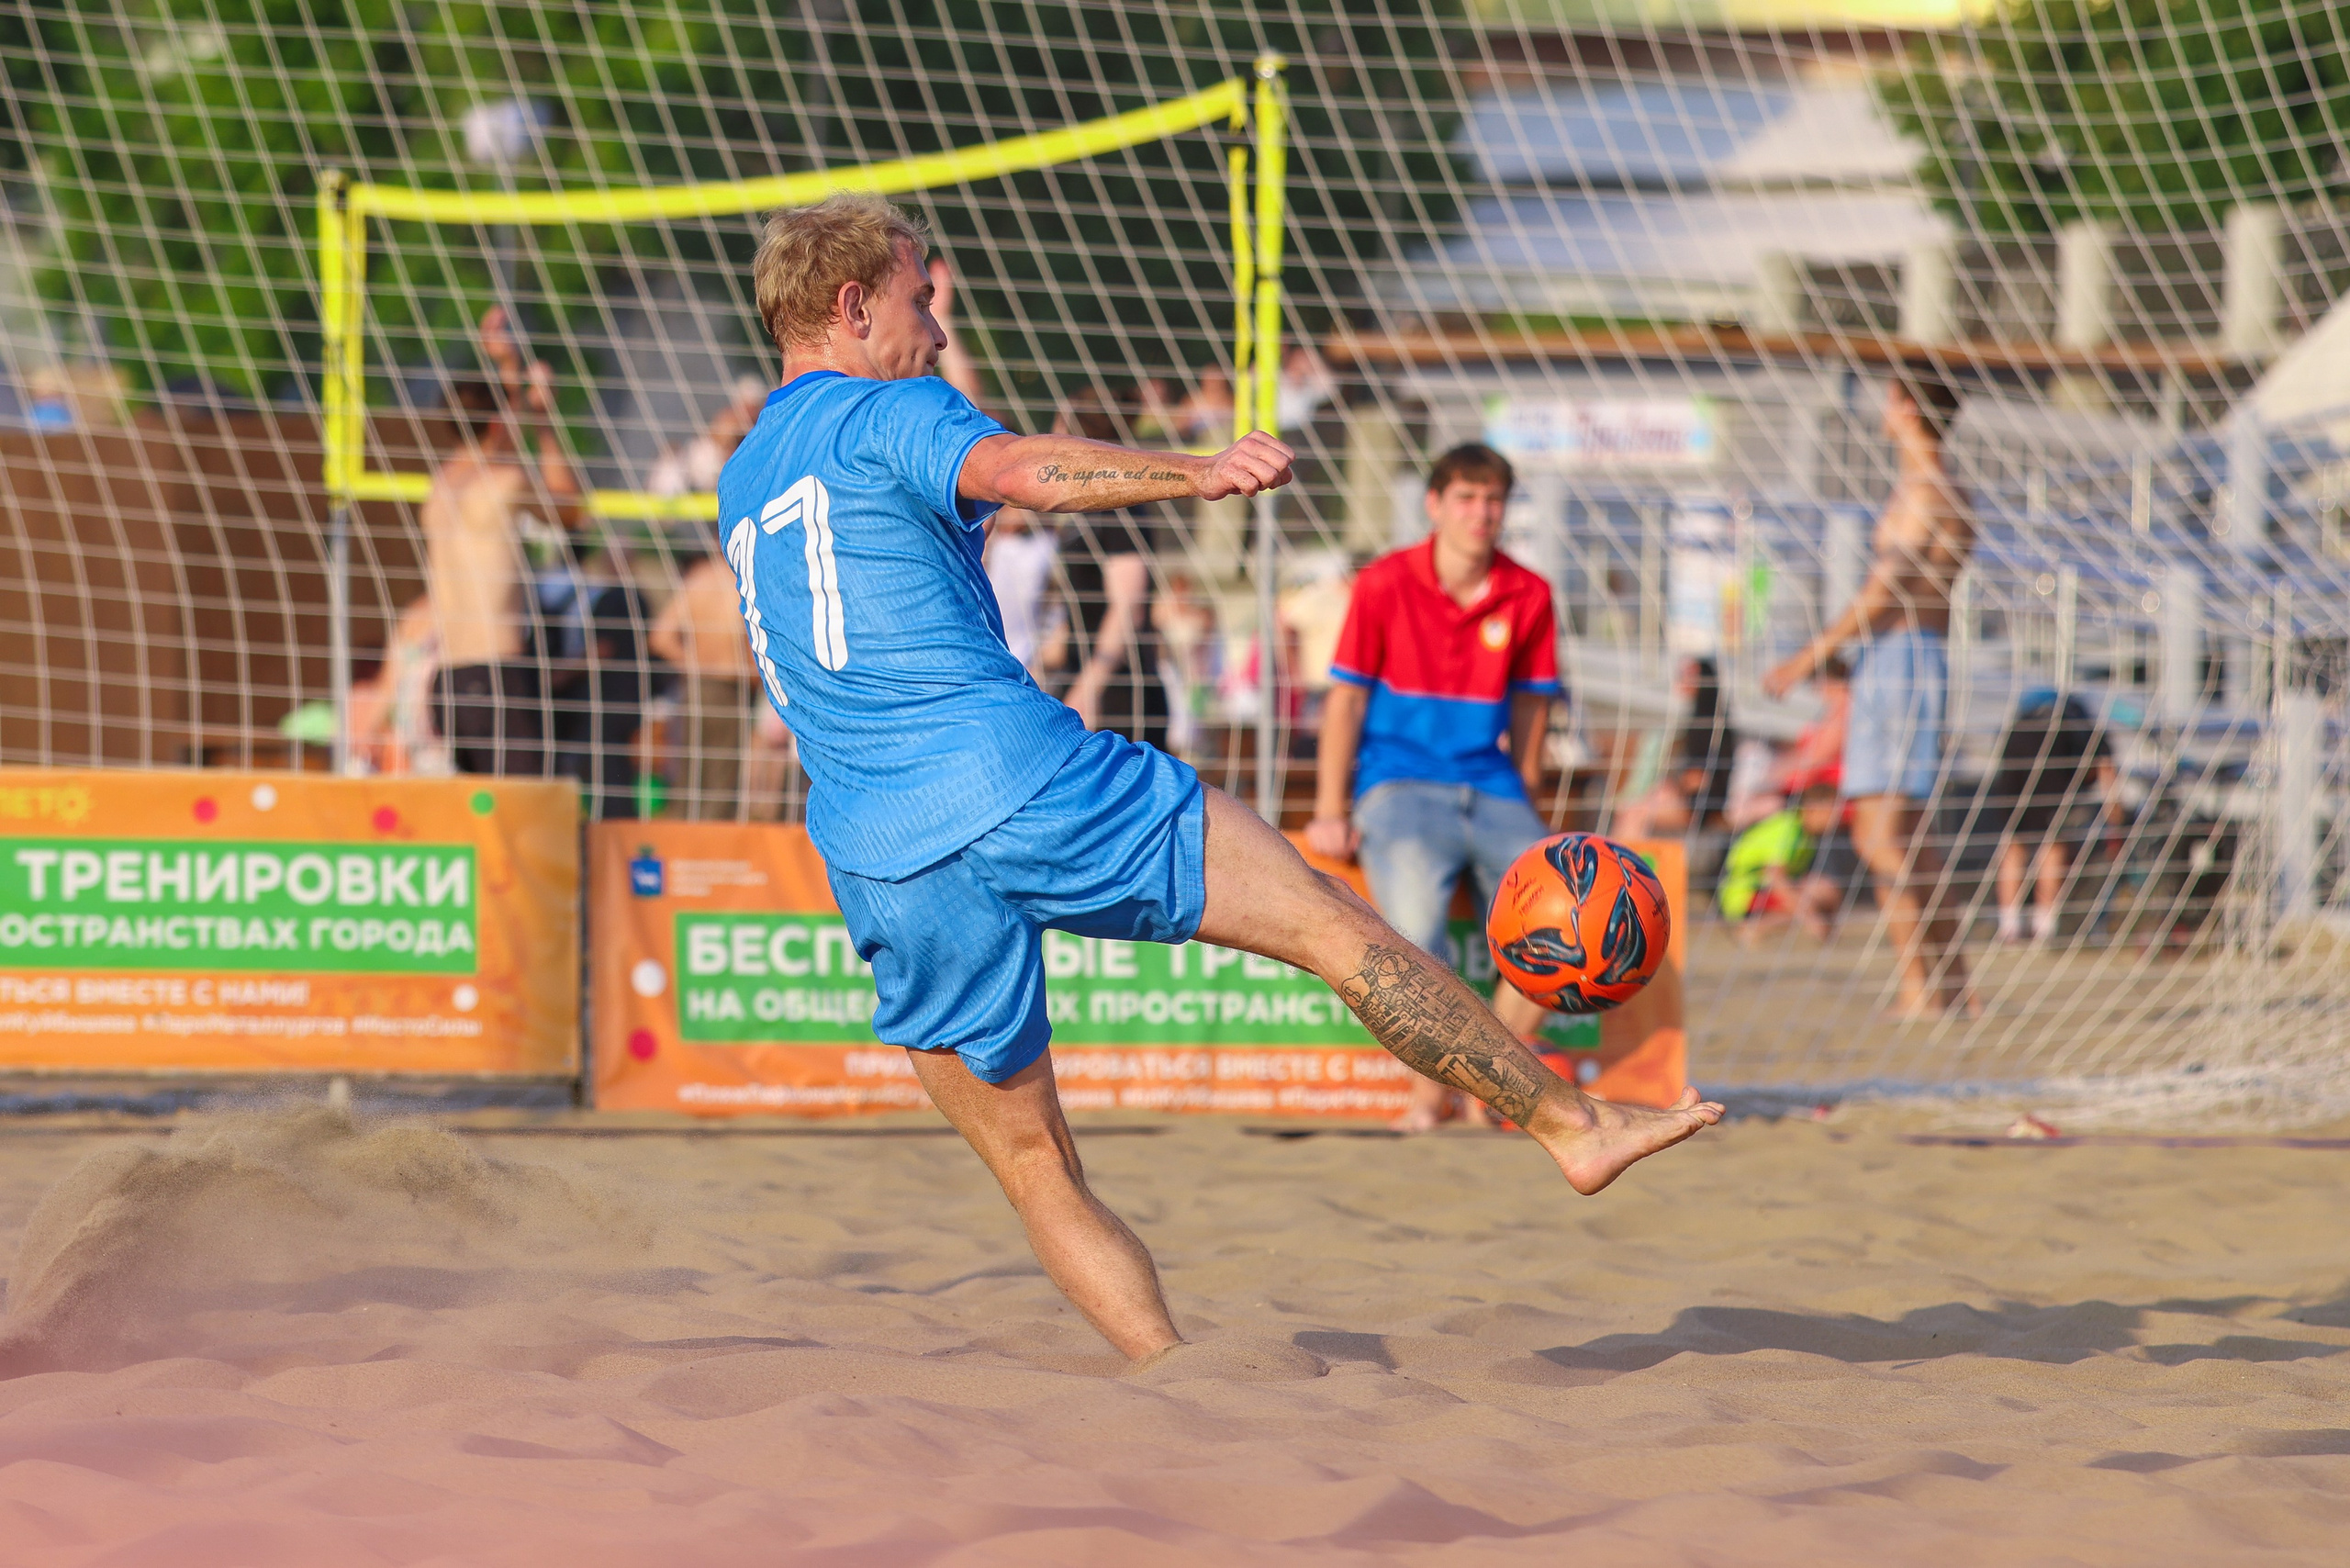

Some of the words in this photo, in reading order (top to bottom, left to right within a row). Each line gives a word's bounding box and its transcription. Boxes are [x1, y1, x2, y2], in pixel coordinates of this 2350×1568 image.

[1037, 465, 1069, 483] Per
[1073, 468, 1118, 487] aspera
[1124, 465, 1149, 480] ad
[1150, 469, 1186, 482] astra
[16, 849, 470, 907] ТРЕНИРОВКИ
[0, 913, 298, 951] ОСТРАНСТВАХ
[310, 919, 476, 957] ГОРОДА
[75, 978, 187, 1006] ВМЕСТЕ
[191, 979, 216, 1007] С
[688, 987, 746, 1022] НА
